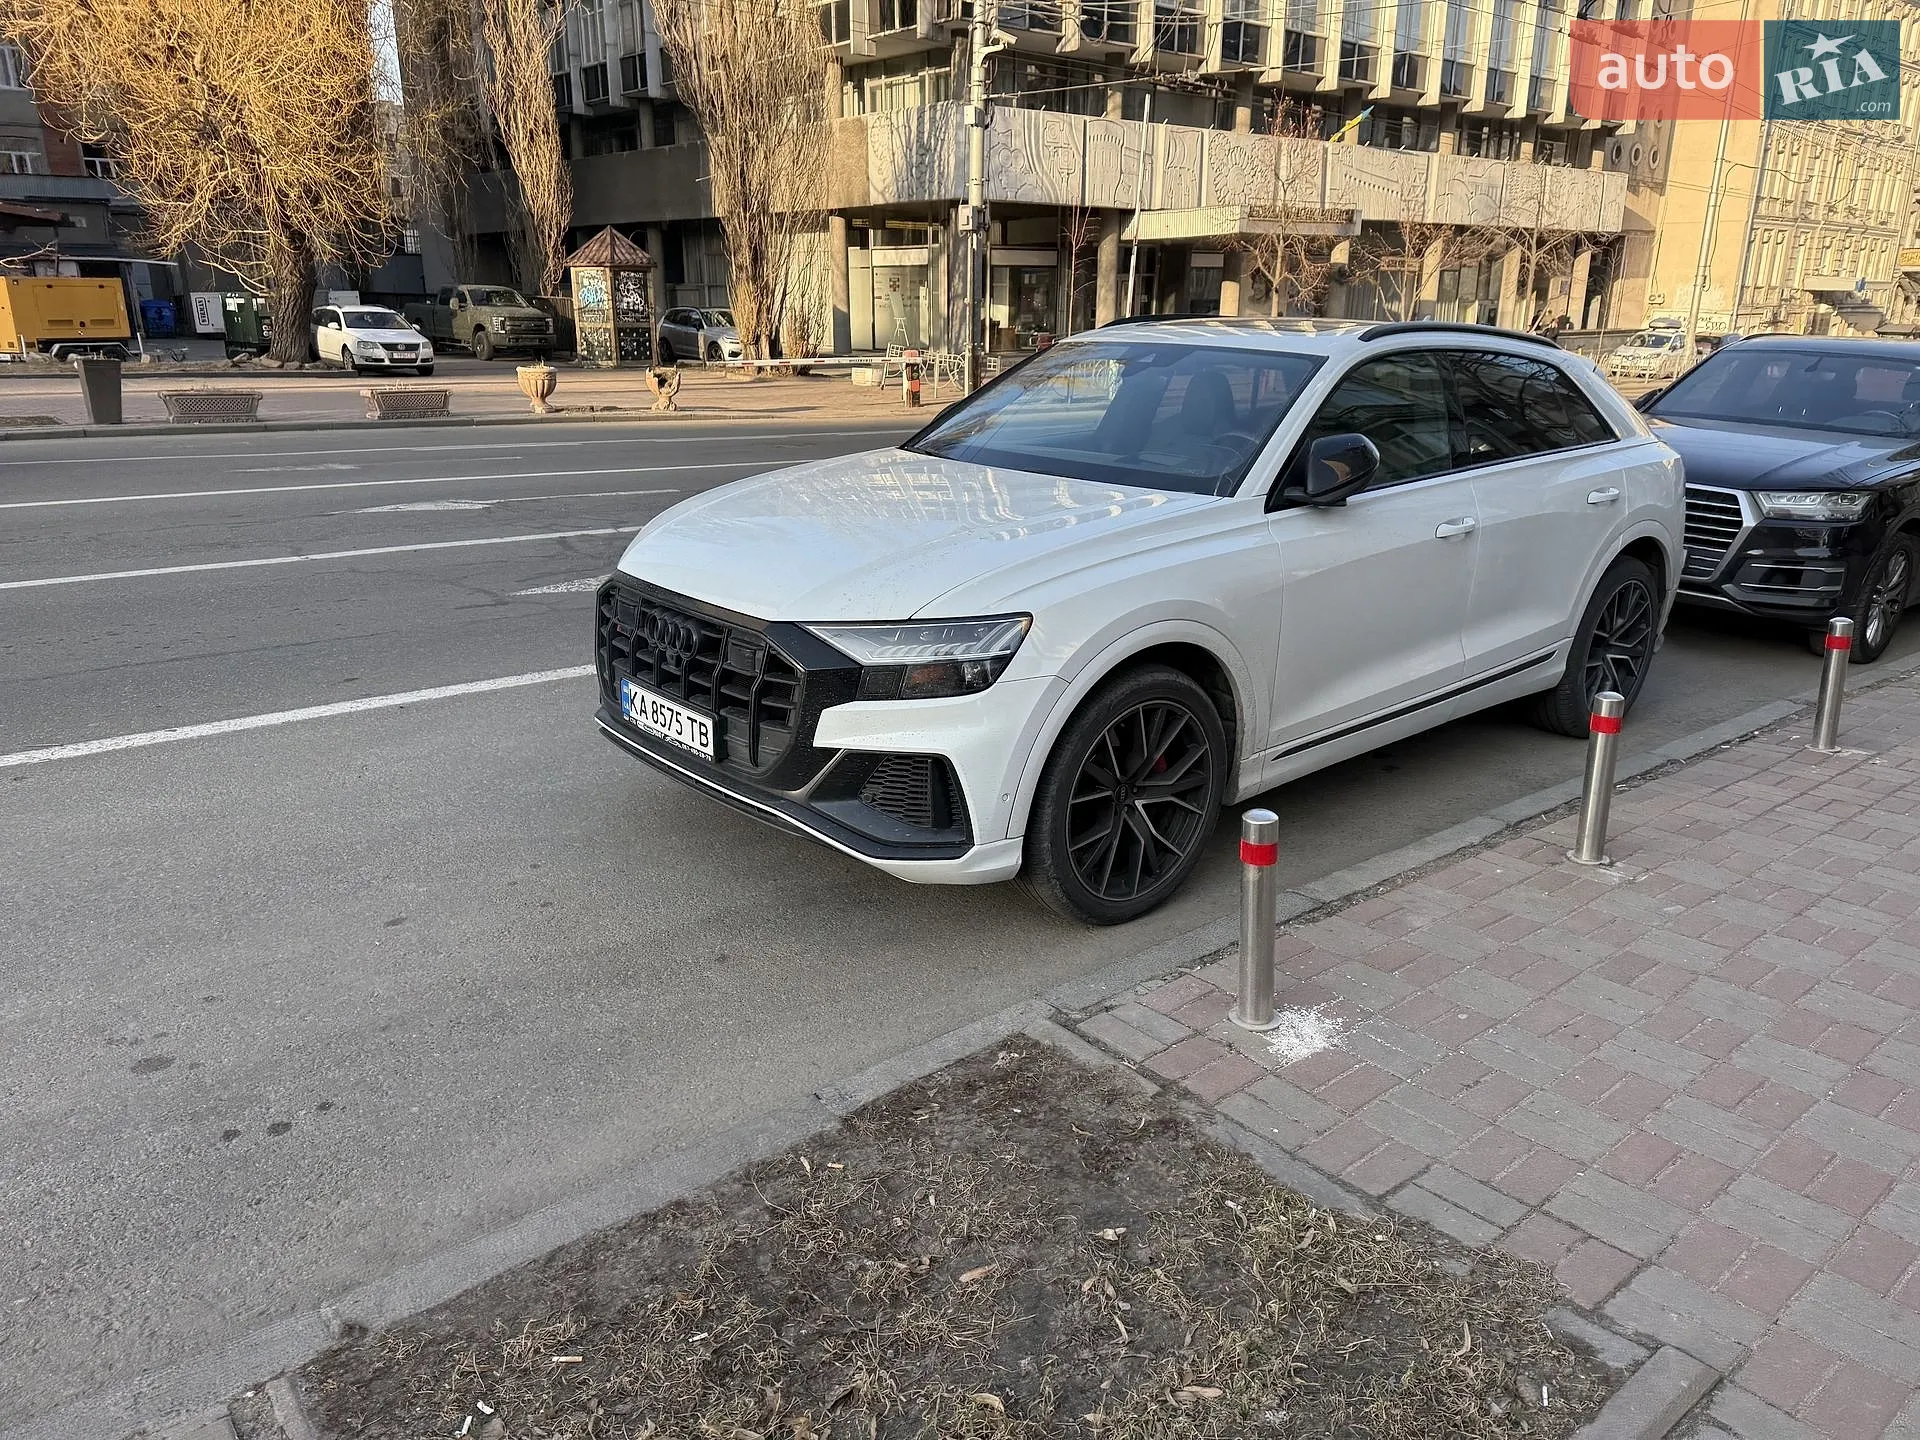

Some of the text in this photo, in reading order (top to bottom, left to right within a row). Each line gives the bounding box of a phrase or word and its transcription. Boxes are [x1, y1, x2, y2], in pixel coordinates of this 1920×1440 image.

[629, 688, 649, 720] KA
[651, 700, 683, 736] 8575
[686, 715, 709, 748] TB
